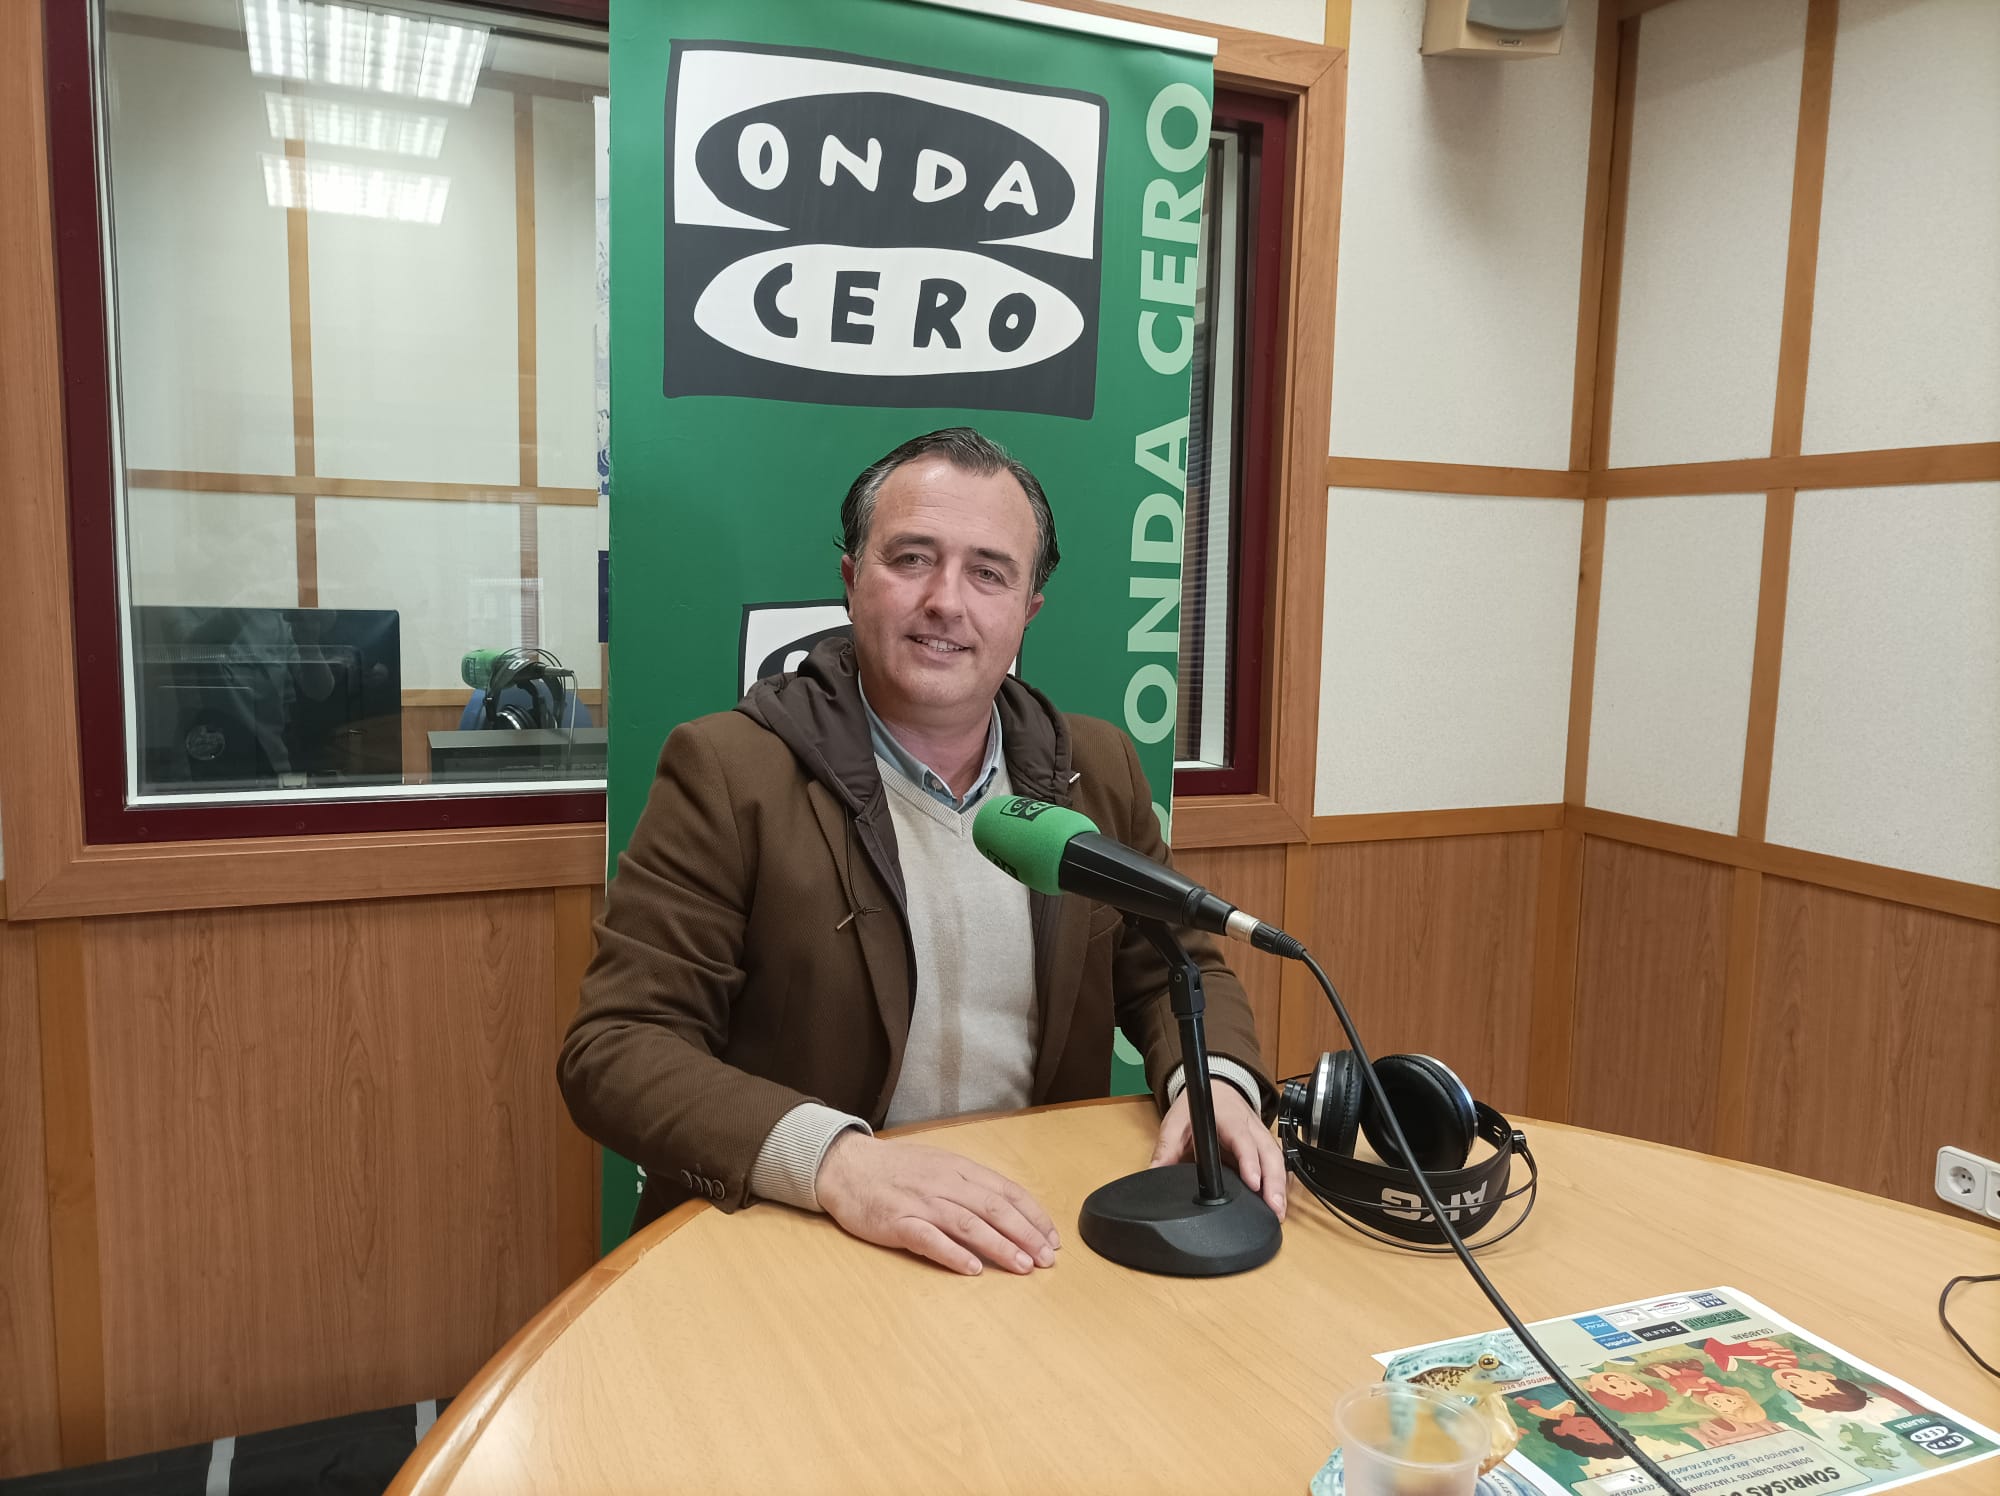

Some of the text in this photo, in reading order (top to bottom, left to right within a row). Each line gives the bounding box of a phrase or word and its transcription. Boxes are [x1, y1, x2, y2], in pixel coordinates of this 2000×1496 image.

[737, 122, 1040, 217] ONDA
[753, 261, 1038, 353] CERO
[1123, 82, 1213, 745] ONDA CERO
[1381, 1180, 1488, 1222] AKG
[1914, 1428, 1945, 1440] CERO
[1929, 1436, 1961, 1449] ONDA
